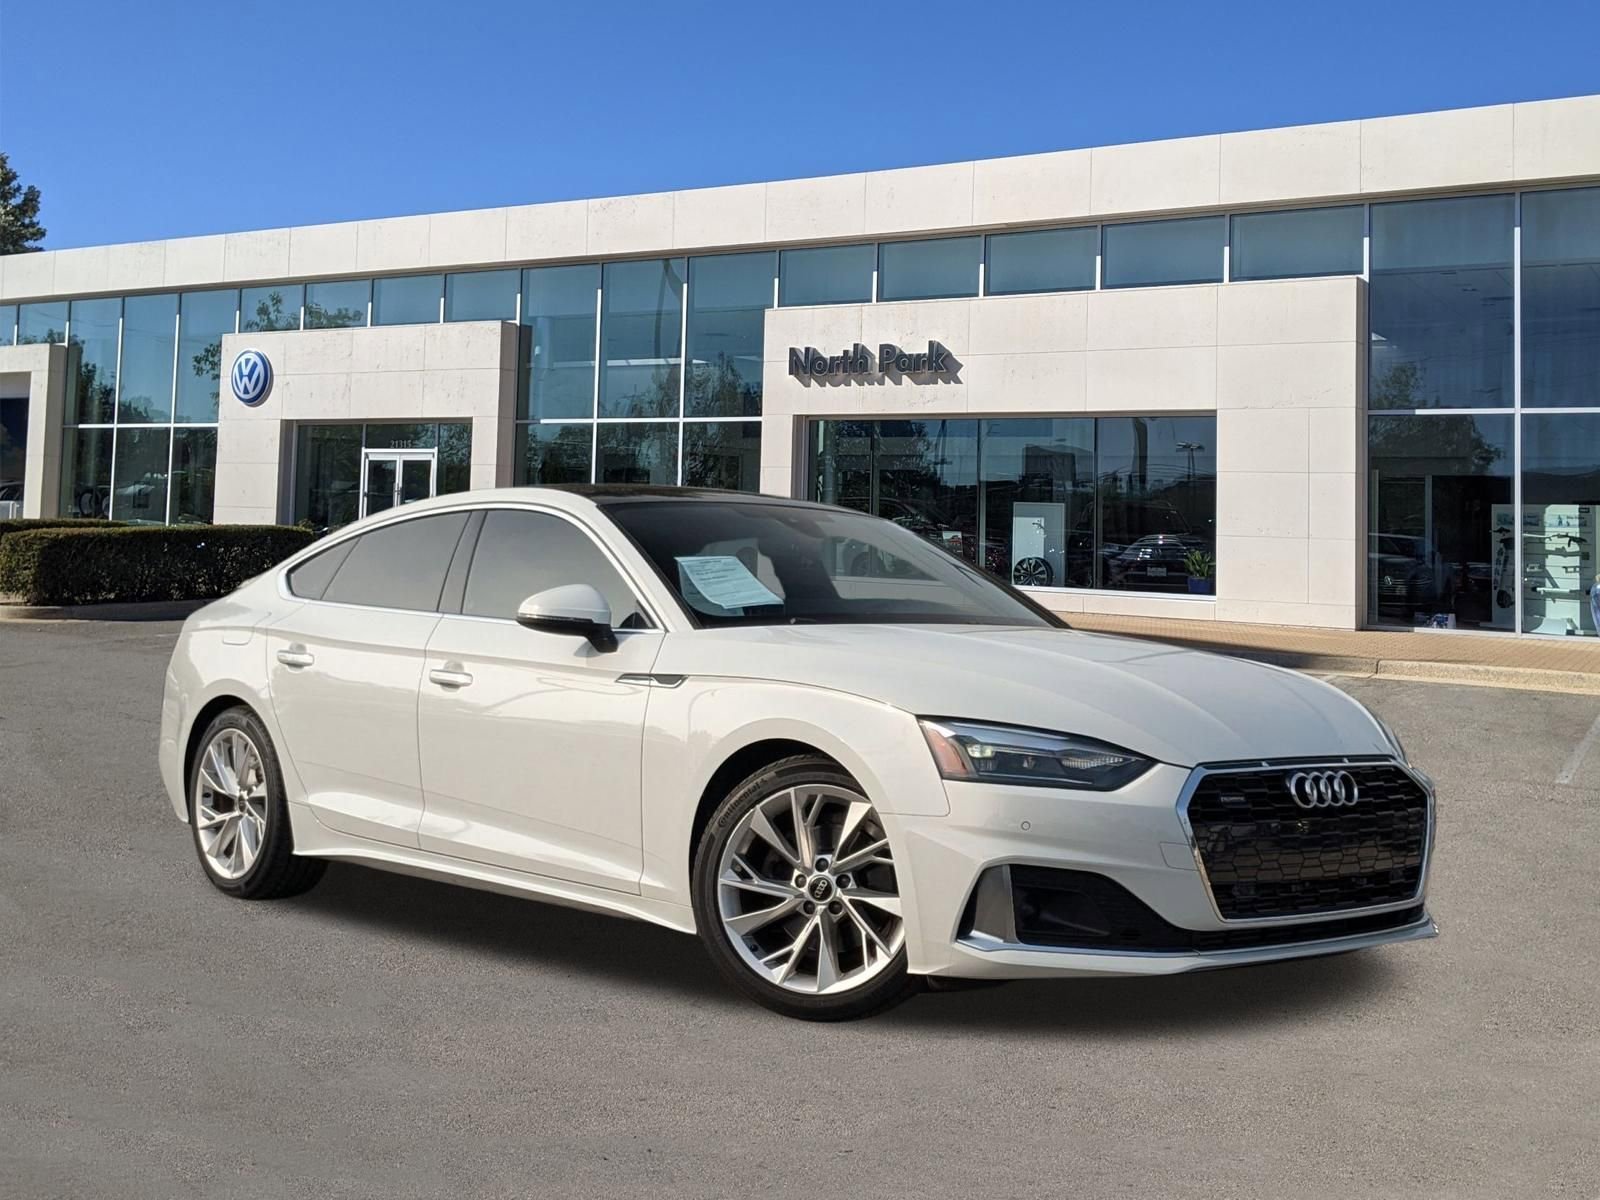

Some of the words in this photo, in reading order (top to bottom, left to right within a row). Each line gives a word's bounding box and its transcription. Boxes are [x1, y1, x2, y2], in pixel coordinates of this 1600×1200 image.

[788, 343, 870, 376] North
[878, 340, 948, 373] Park
[390, 440, 412, 449] 21315
